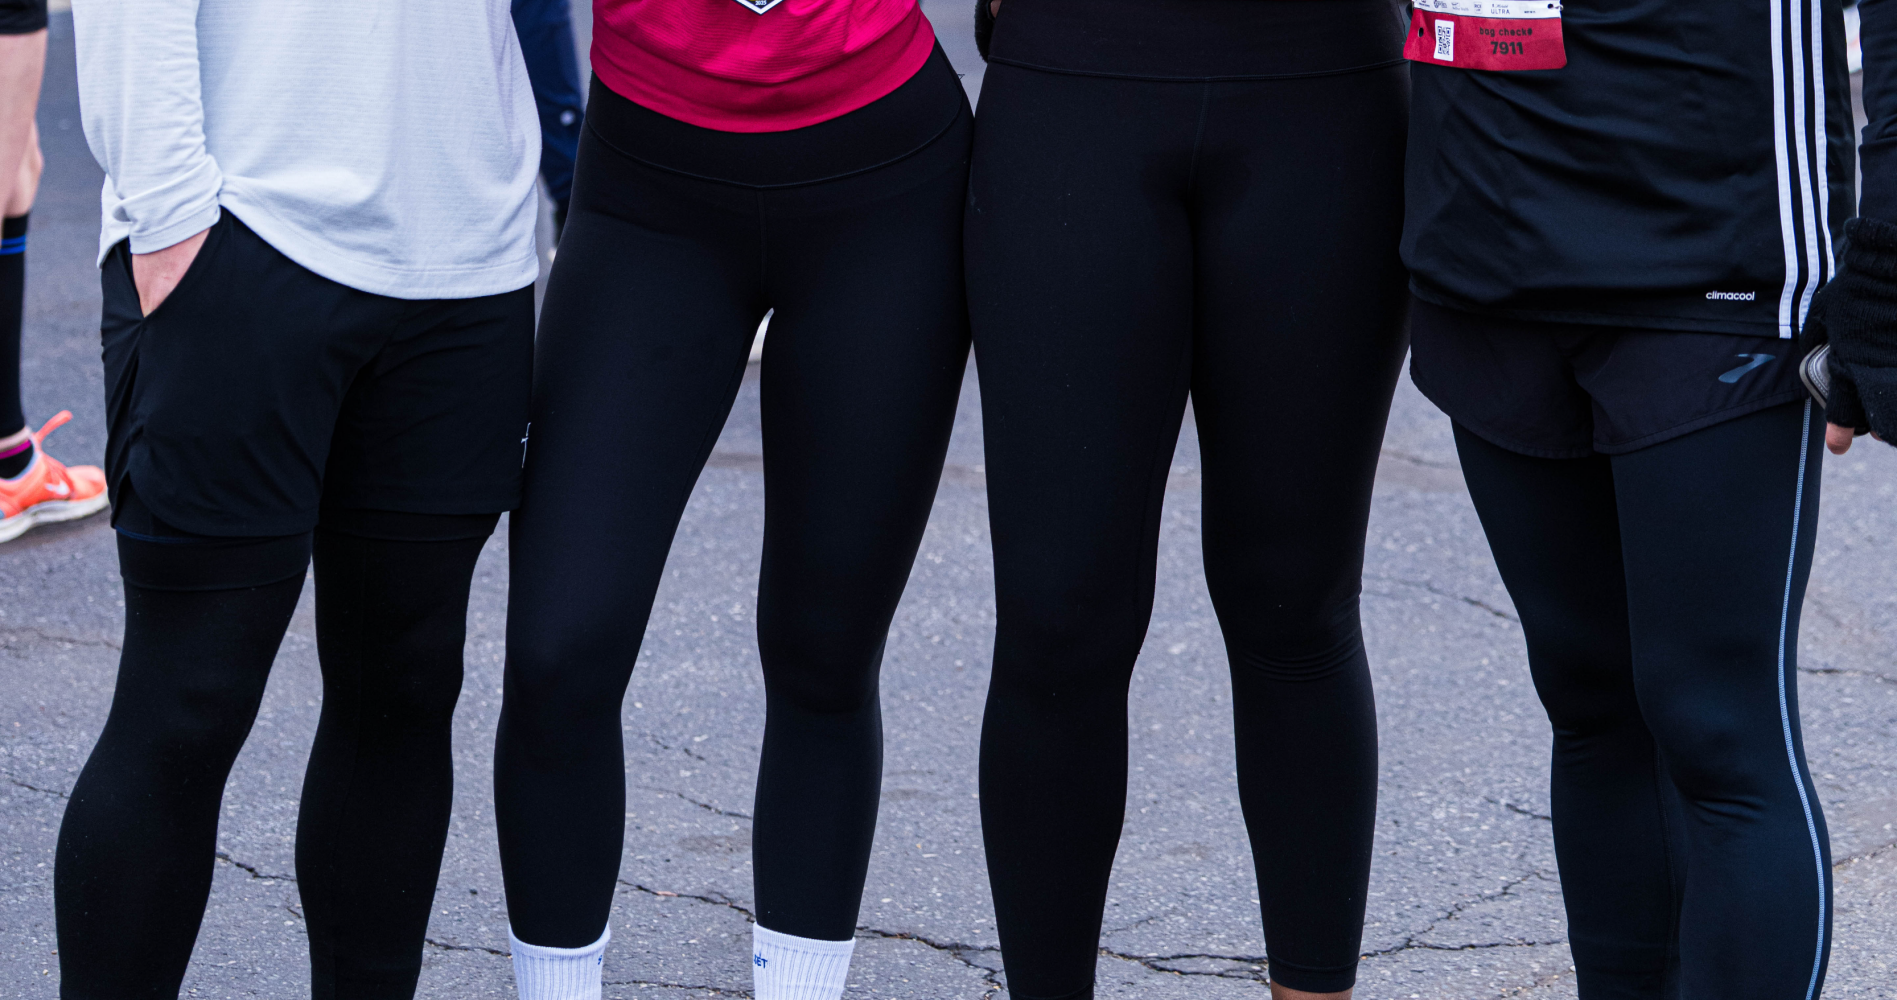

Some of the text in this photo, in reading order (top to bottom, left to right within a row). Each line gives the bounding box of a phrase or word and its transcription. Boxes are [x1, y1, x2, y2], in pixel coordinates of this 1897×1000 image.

[1479, 27, 1495, 37] bag
[1490, 41, 1524, 55] 7911
[1705, 290, 1756, 301] climacool
